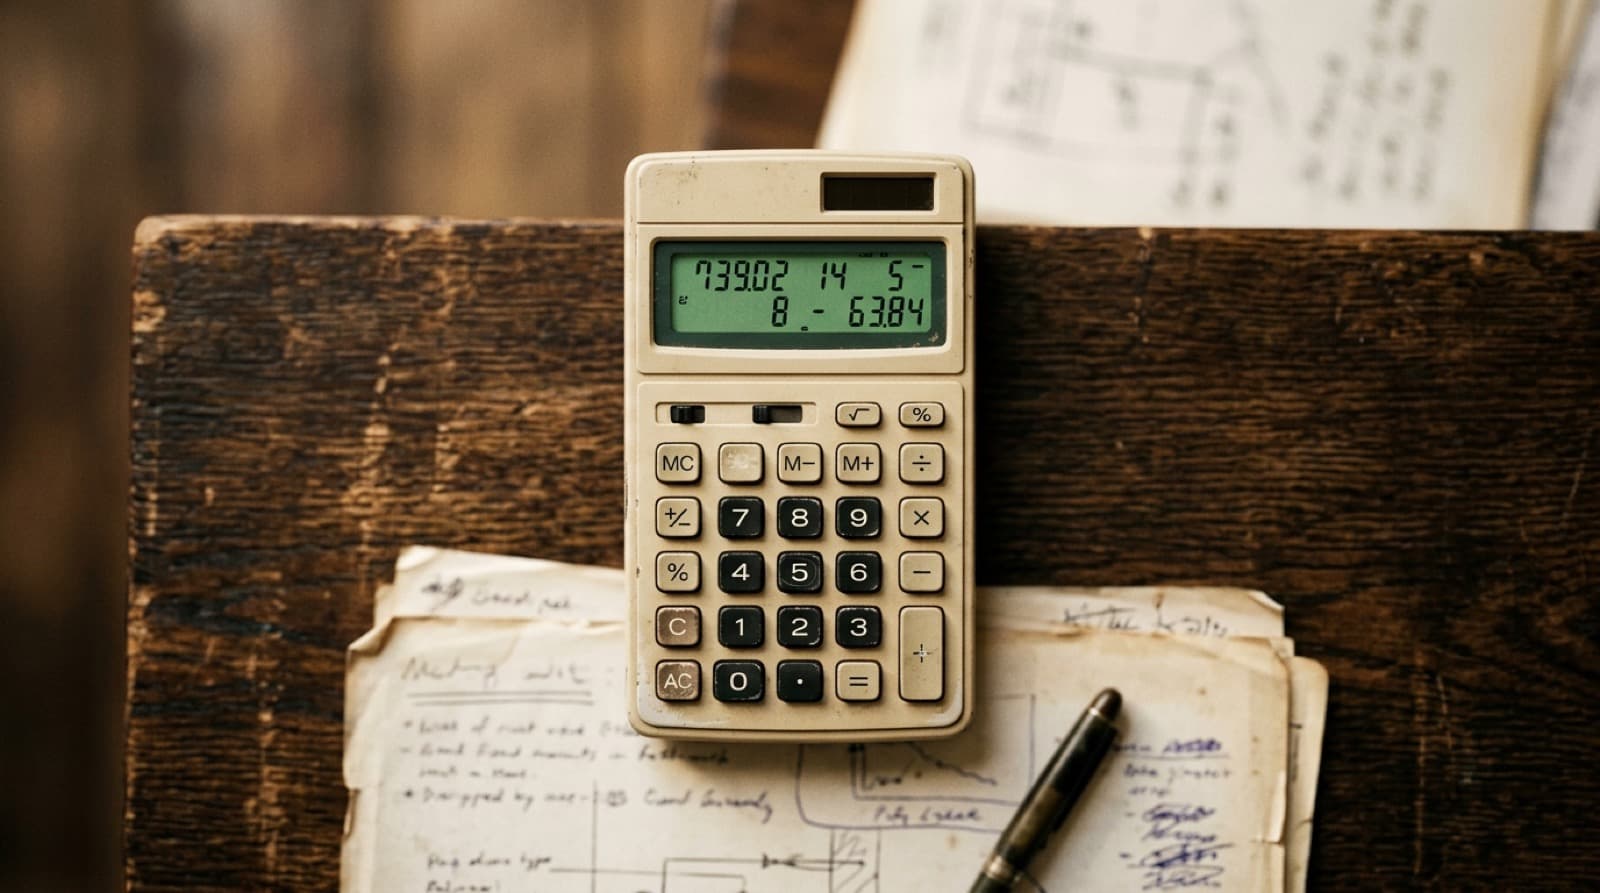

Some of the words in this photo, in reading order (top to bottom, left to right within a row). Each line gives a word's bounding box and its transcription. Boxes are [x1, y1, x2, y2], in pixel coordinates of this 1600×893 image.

[695, 259, 789, 292] 739.02
[820, 262, 847, 291] 14
[771, 295, 789, 328] 8
[848, 295, 924, 329] 63.84
[911, 406, 932, 423] %
[662, 455, 695, 472] MC
[843, 455, 874, 472] M+
[732, 508, 749, 527] 7
[791, 508, 809, 528] 8
[850, 508, 868, 528] 9
[667, 562, 689, 582] %
[731, 563, 750, 581] 4
[791, 563, 809, 582] 5
[850, 562, 868, 582] 6
[668, 617, 687, 636] C
[735, 618, 744, 637] 1
[791, 617, 809, 637] 2
[850, 617, 867, 637] 3
[663, 672, 693, 689] AC
[729, 671, 748, 691] 0
